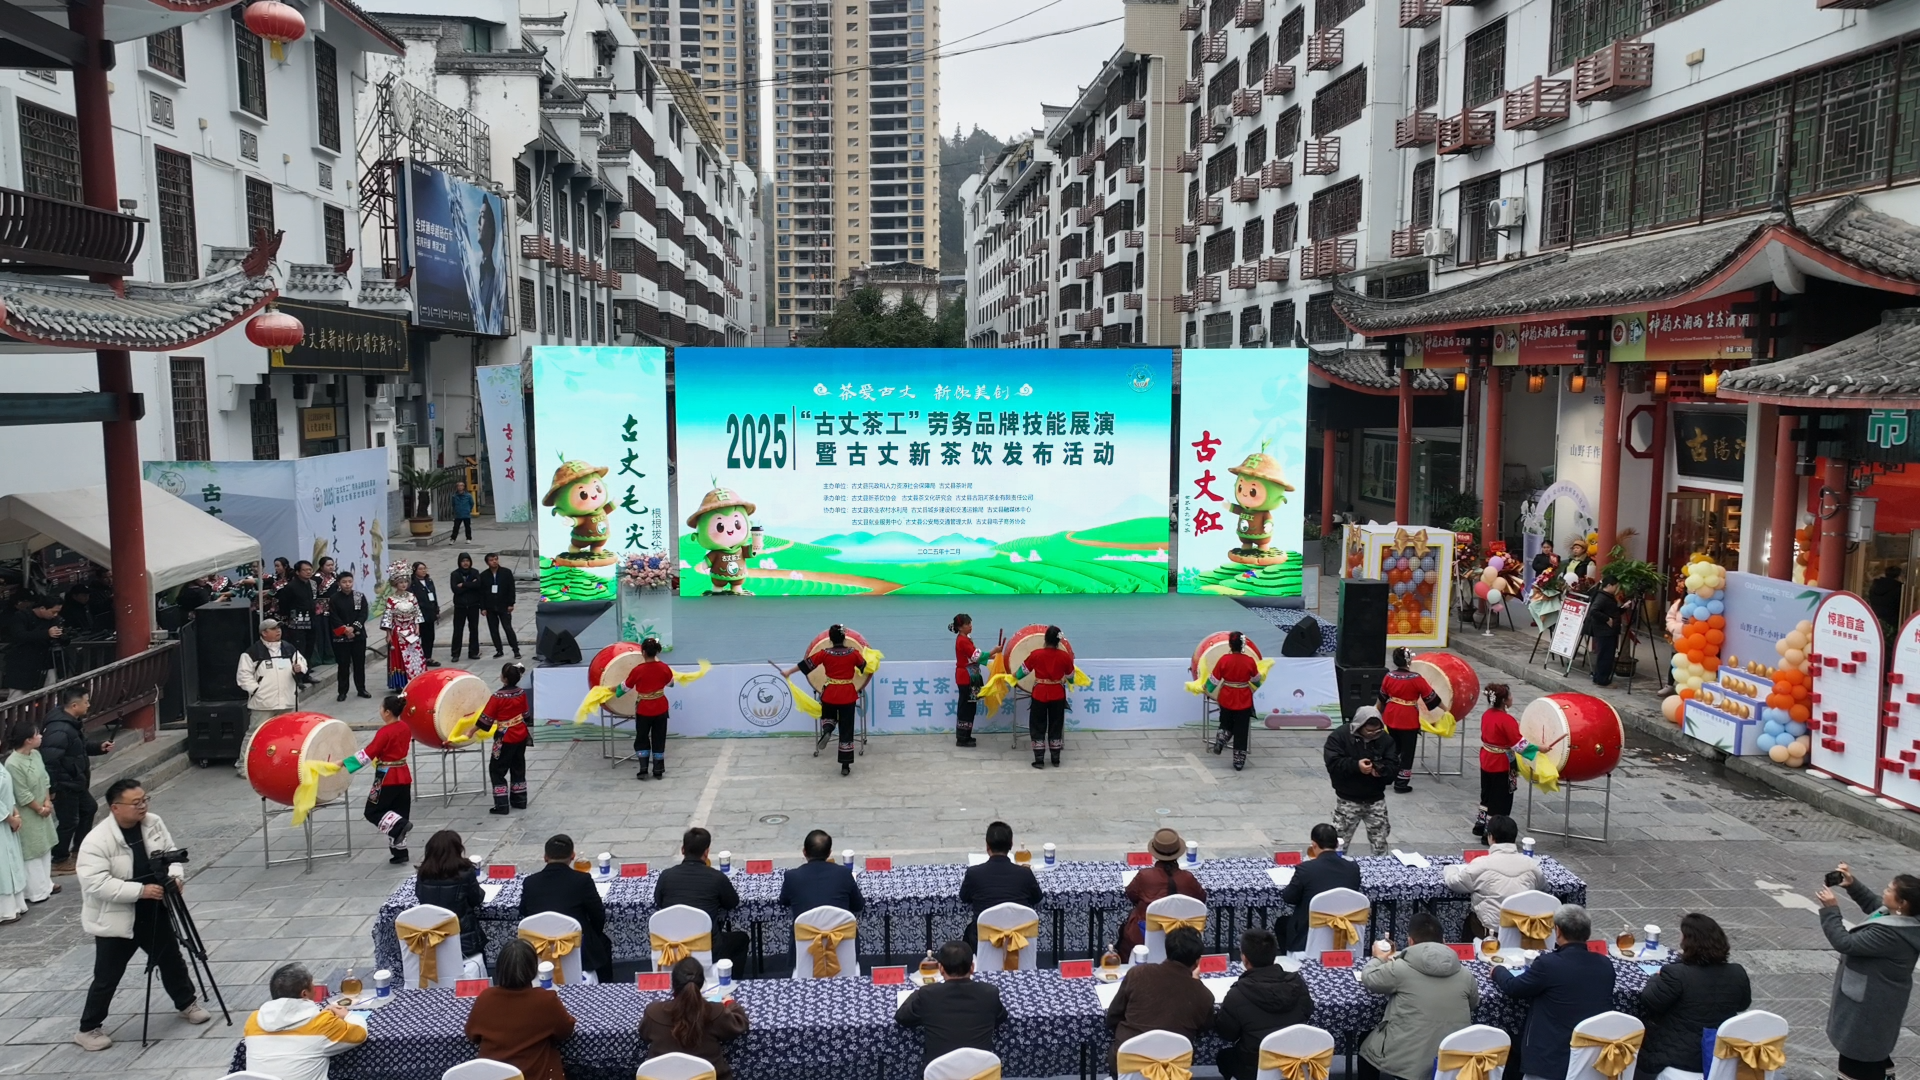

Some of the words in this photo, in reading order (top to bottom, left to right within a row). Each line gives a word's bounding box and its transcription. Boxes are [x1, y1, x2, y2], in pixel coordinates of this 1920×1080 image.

[838, 383, 916, 401] 茶爱古丈
[801, 410, 1115, 436] “古丈茶工”劳务品牌技能展演
[726, 413, 787, 469] 2025
[815, 441, 1115, 466] 暨古丈新茶饮发布活动
[1570, 444, 1601, 458] 山野手作
[617, 414, 649, 549] 古丈毛尖
[651, 508, 662, 550] 根根拔尖
[1828, 612, 1865, 632] 惊喜盲盒
